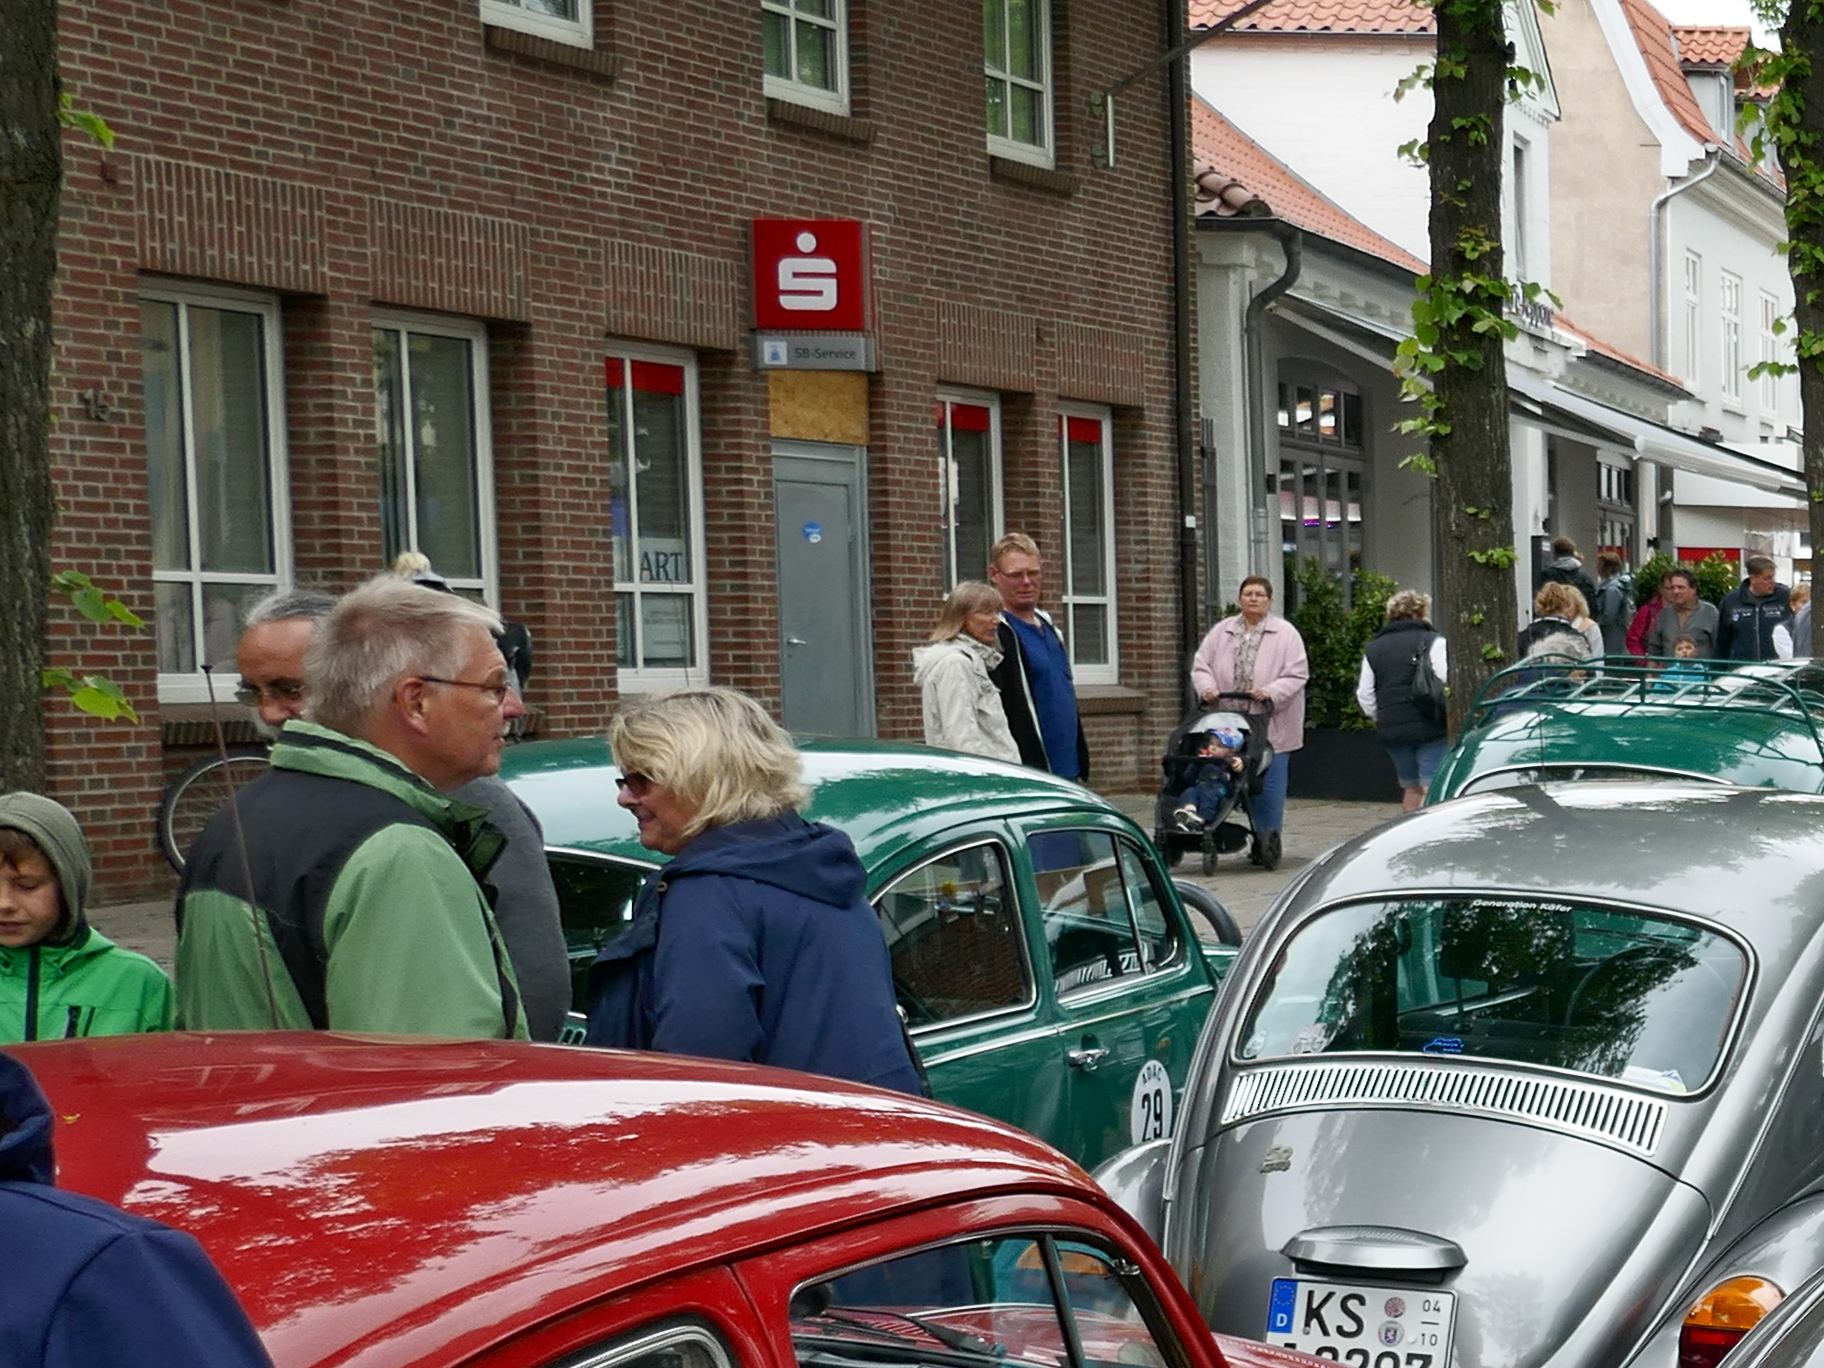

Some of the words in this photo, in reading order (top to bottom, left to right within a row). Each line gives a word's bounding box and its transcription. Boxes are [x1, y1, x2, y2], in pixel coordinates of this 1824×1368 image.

[794, 347, 857, 360] SB-Service
[1472, 899, 1537, 910] Generation
[1141, 1066, 1163, 1085] ADAC
[1141, 1088, 1164, 1143] 29
[1423, 1299, 1442, 1313] 04
[1276, 1313, 1288, 1327] D
[1303, 1289, 1367, 1339] KS
[1420, 1333, 1438, 1346] 10
